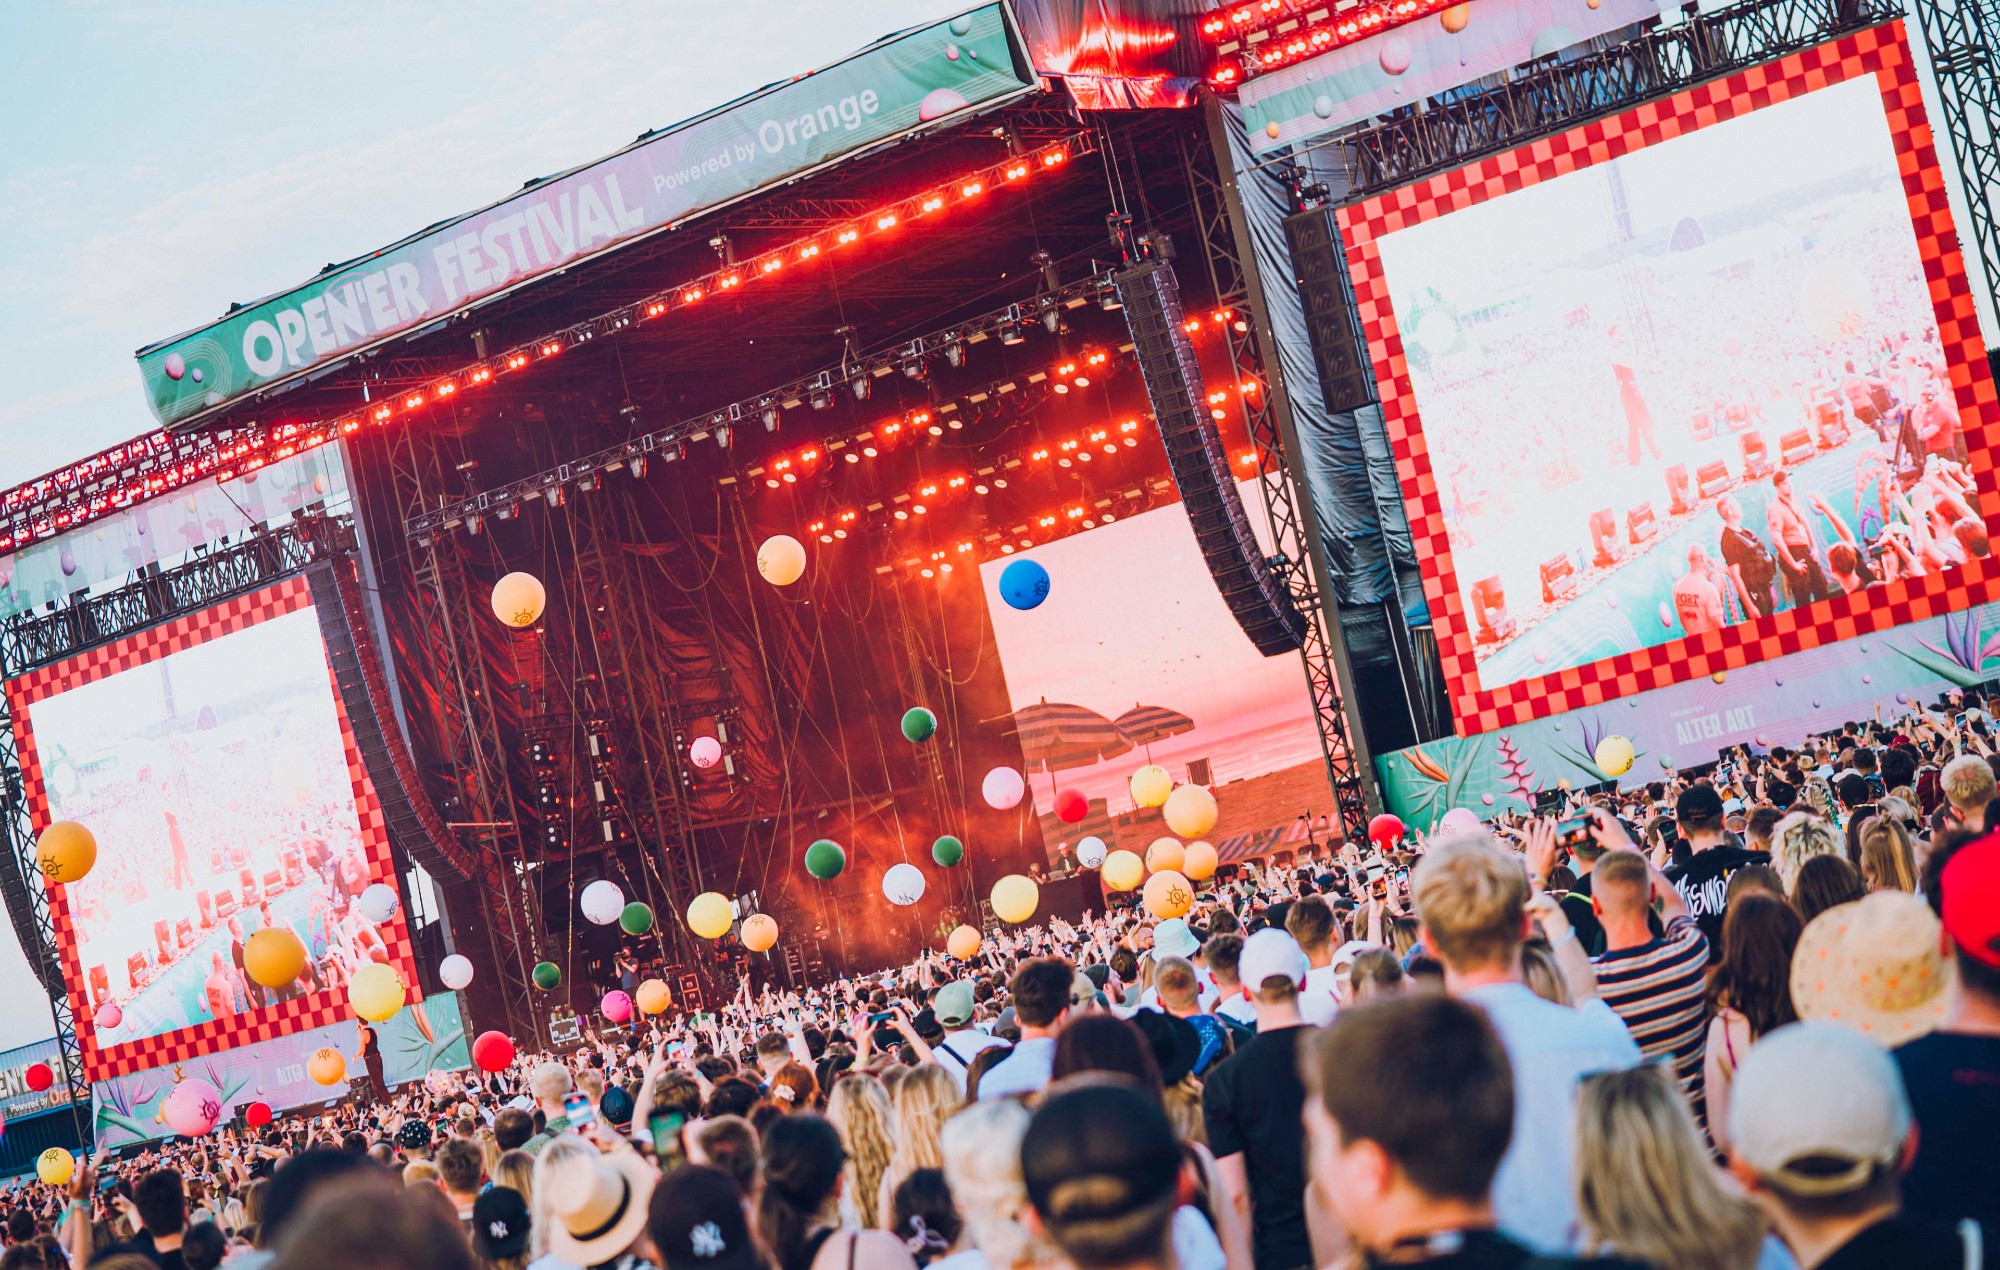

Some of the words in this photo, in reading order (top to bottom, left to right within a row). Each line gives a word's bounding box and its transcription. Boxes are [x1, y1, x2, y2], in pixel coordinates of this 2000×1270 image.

[243, 262, 431, 378] OPEN'ER
[432, 173, 645, 302] FESTIVAL
[653, 148, 732, 194] Powered
[734, 142, 756, 162] by
[758, 89, 880, 154] Orange
[1675, 713, 1725, 746] ALTER
[1726, 705, 1756, 734] ART
[276, 1063, 306, 1087] ALTER
[10, 1098, 40, 1113] Powered
